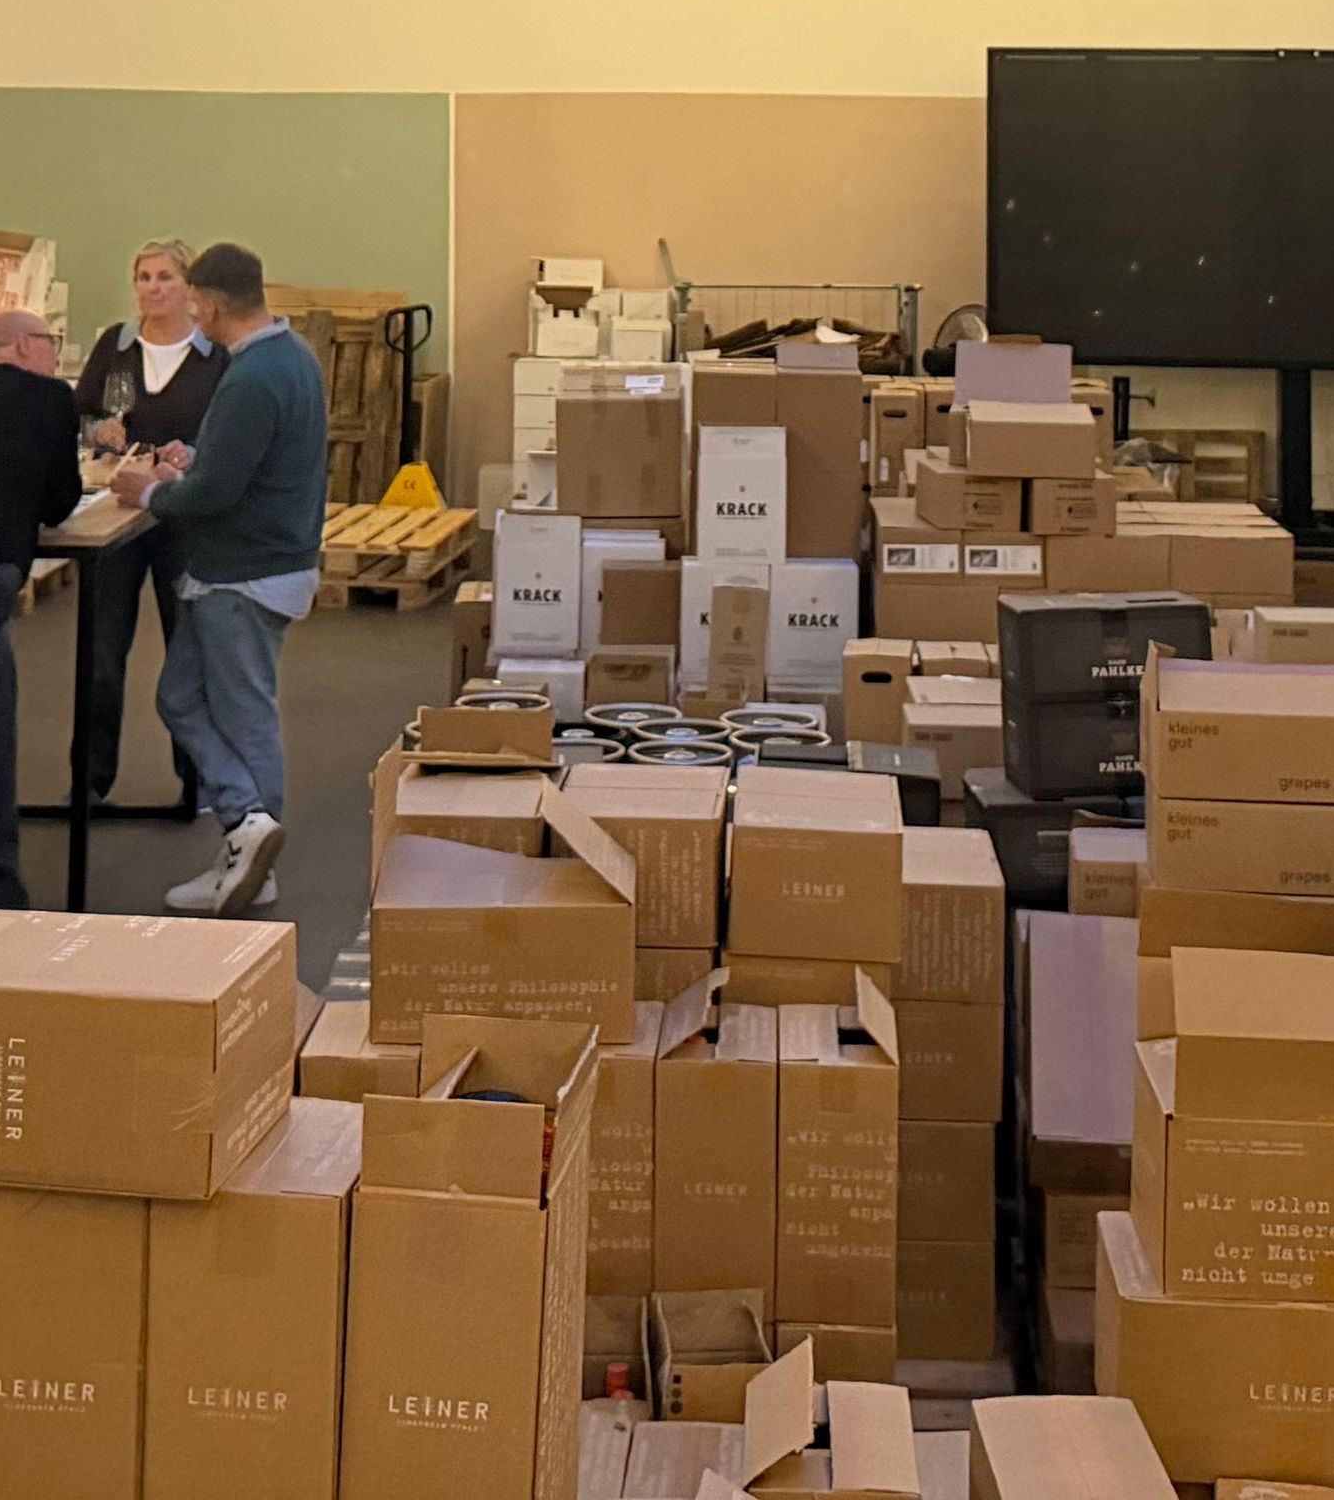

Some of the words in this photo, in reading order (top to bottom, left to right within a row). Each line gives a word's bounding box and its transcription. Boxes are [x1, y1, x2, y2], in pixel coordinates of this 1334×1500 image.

[717, 502, 767, 516] KRACK
[513, 588, 562, 602] KRACK
[788, 613, 839, 628] KRACK
[1168, 722, 1219, 735] kleines
[1168, 737, 1192, 750] gut
[1099, 761, 1141, 773] PAHLK
[1279, 776, 1330, 791] grapes
[1168, 813, 1219, 827] kleines
[1167, 828, 1192, 841] gut
[1279, 870, 1331, 885] grapes
[509, 981, 618, 995] Philosophie
[5, 1037, 26, 1140] LEINER
[1251, 1197, 1330, 1214] wollen
[1214, 1242, 1253, 1259] der
[1181, 1267, 1247, 1284] nicht
[187, 1386, 288, 1412] LEINER
[388, 1394, 489, 1420] LEINER
